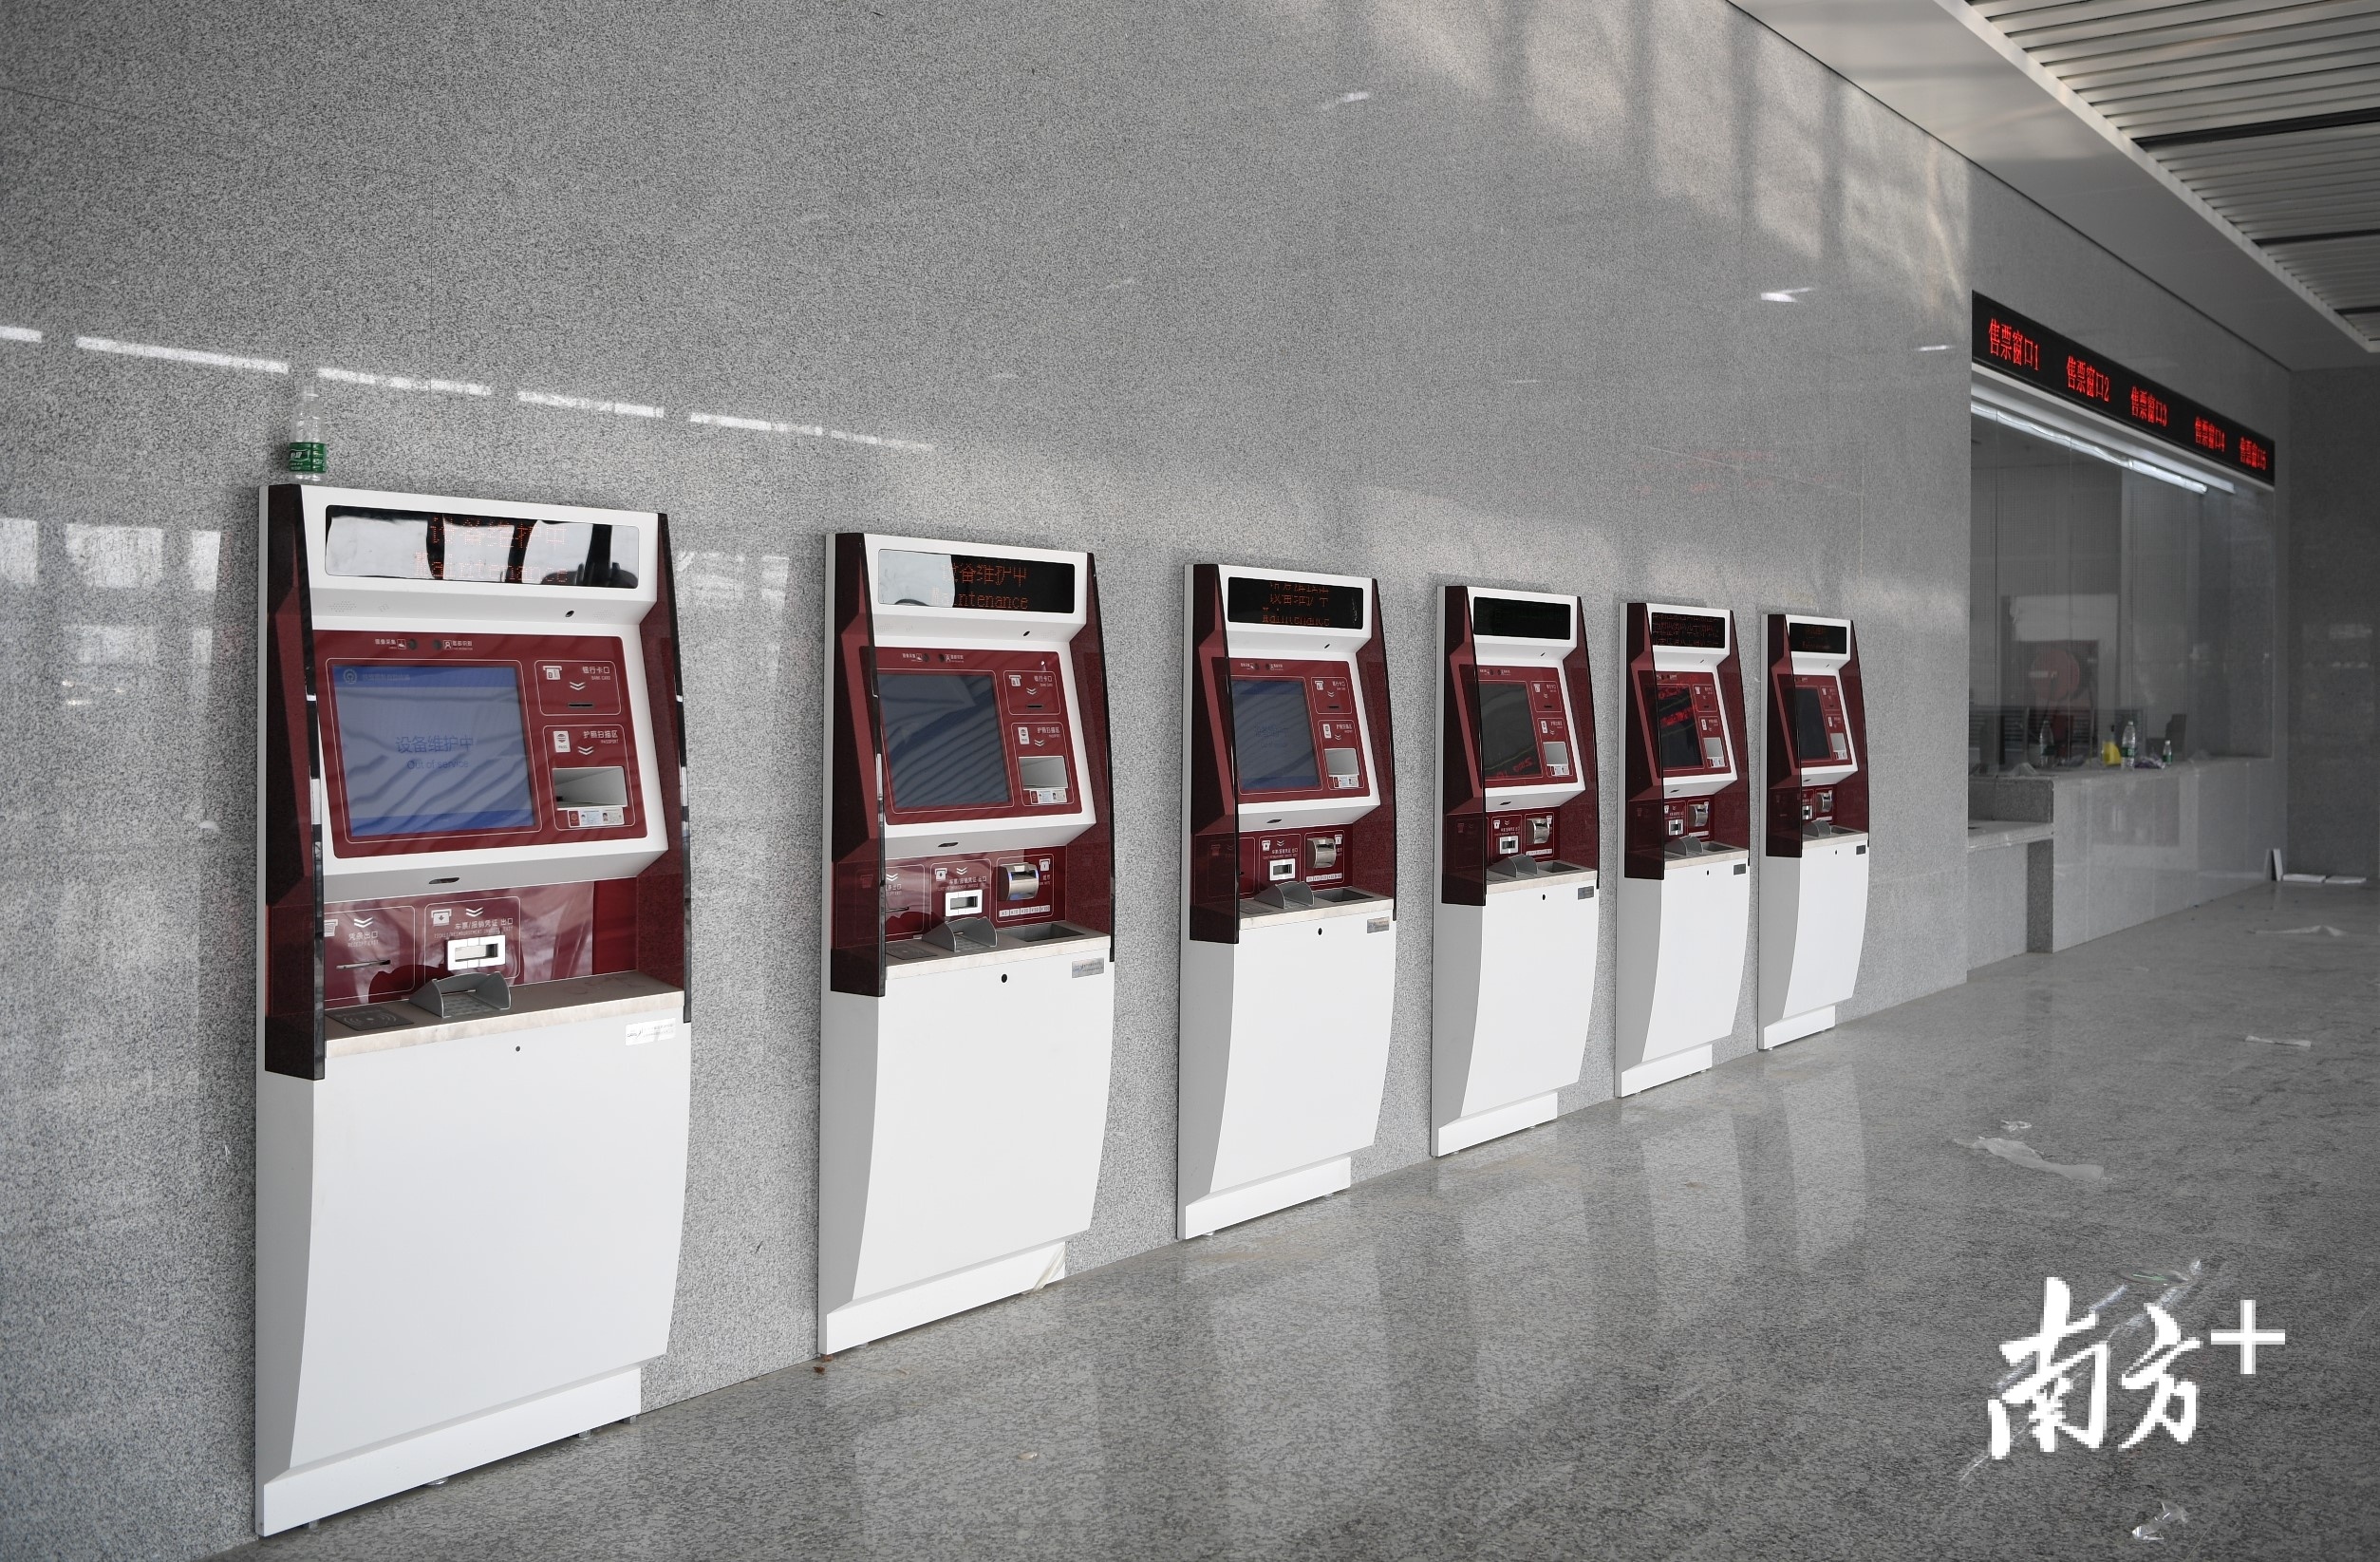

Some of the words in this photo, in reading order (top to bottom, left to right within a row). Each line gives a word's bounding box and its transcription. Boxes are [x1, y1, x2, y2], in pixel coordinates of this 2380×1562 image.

[1988, 318, 2039, 370] 售票窗口1
[2066, 355, 2109, 402] 售票窗口2
[2131, 386, 2167, 426] 售票窗口3
[395, 734, 474, 753] 设备维护中
[406, 760, 424, 769] Out
[426, 759, 436, 769] of
[438, 760, 470, 769] service
